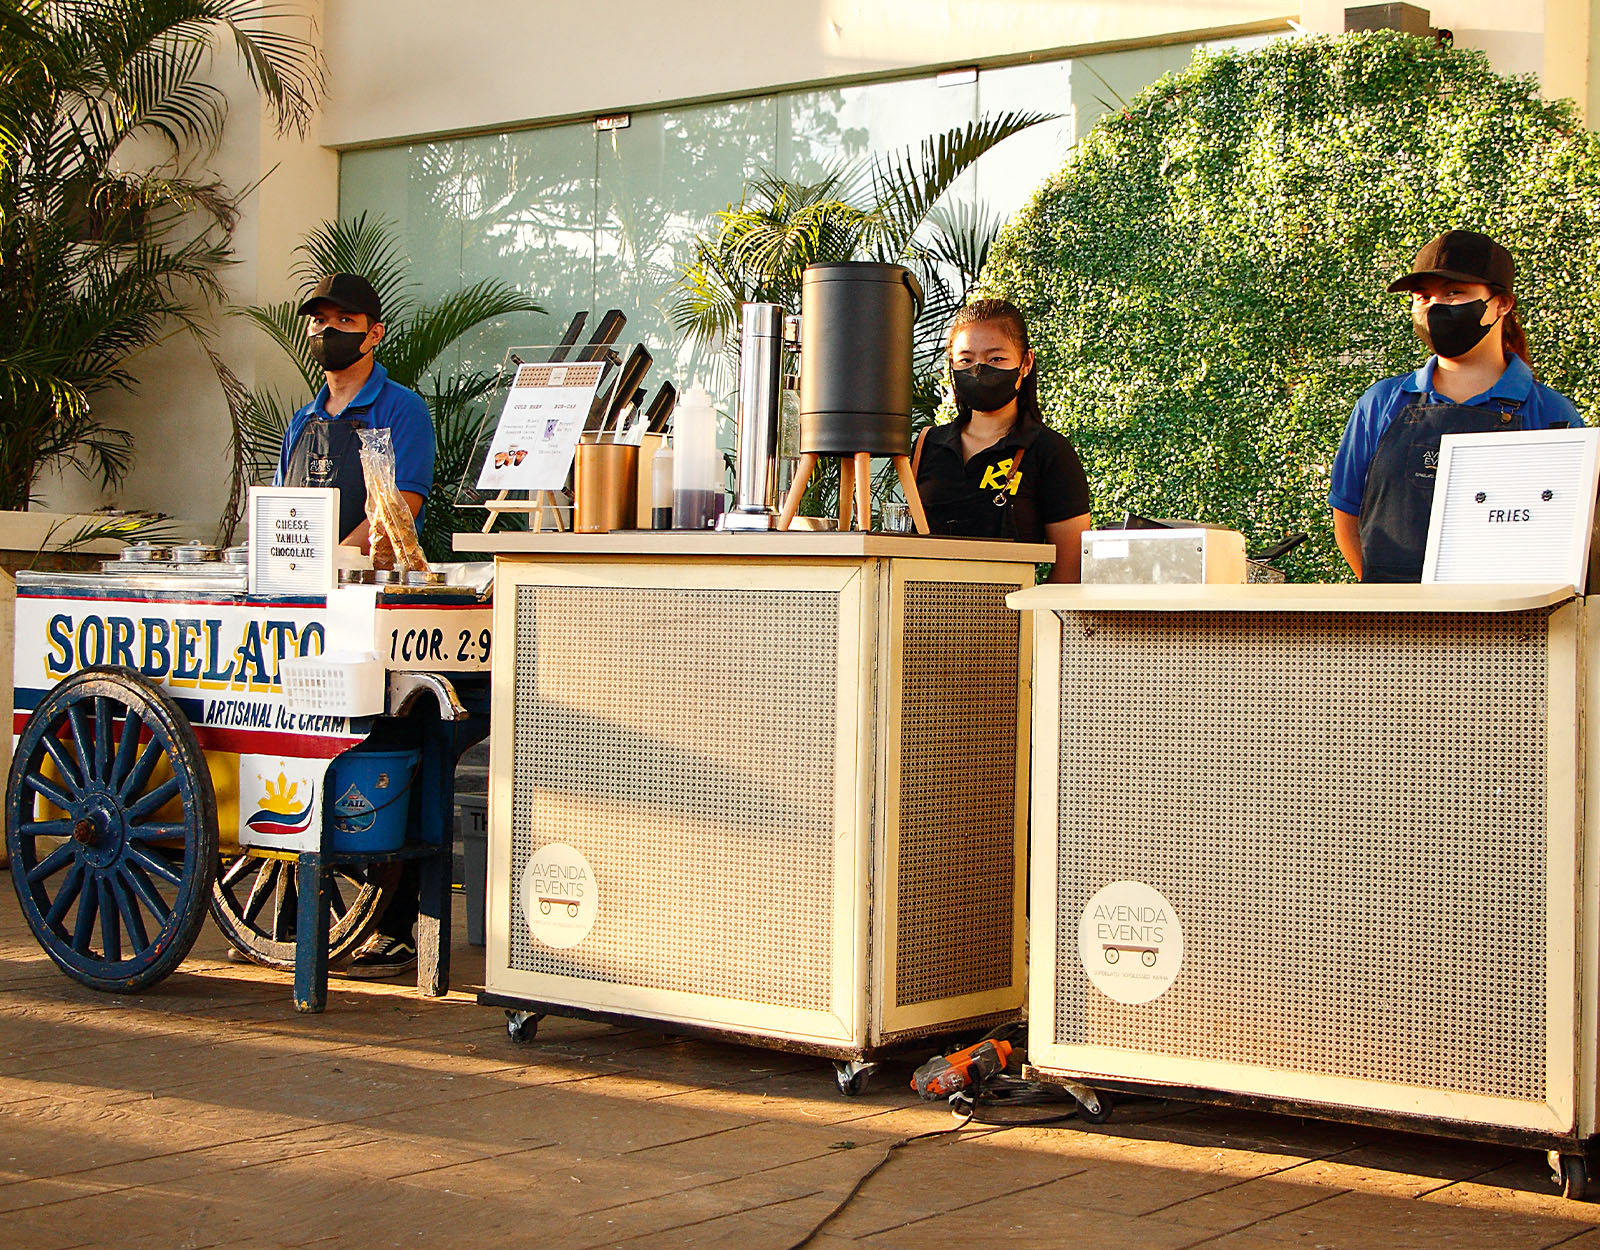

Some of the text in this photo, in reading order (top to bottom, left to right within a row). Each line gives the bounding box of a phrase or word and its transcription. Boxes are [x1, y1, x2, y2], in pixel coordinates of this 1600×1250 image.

[1488, 509, 1530, 522] FRIES
[275, 519, 309, 530] CHEESE
[275, 533, 310, 544] VANILLA
[270, 546, 315, 558] CHOCOLATE
[45, 613, 326, 692] SORBELATO
[205, 699, 273, 728] ARTISANAL
[535, 879, 584, 897] EVENTS
[1097, 923, 1164, 943] EVENTS
